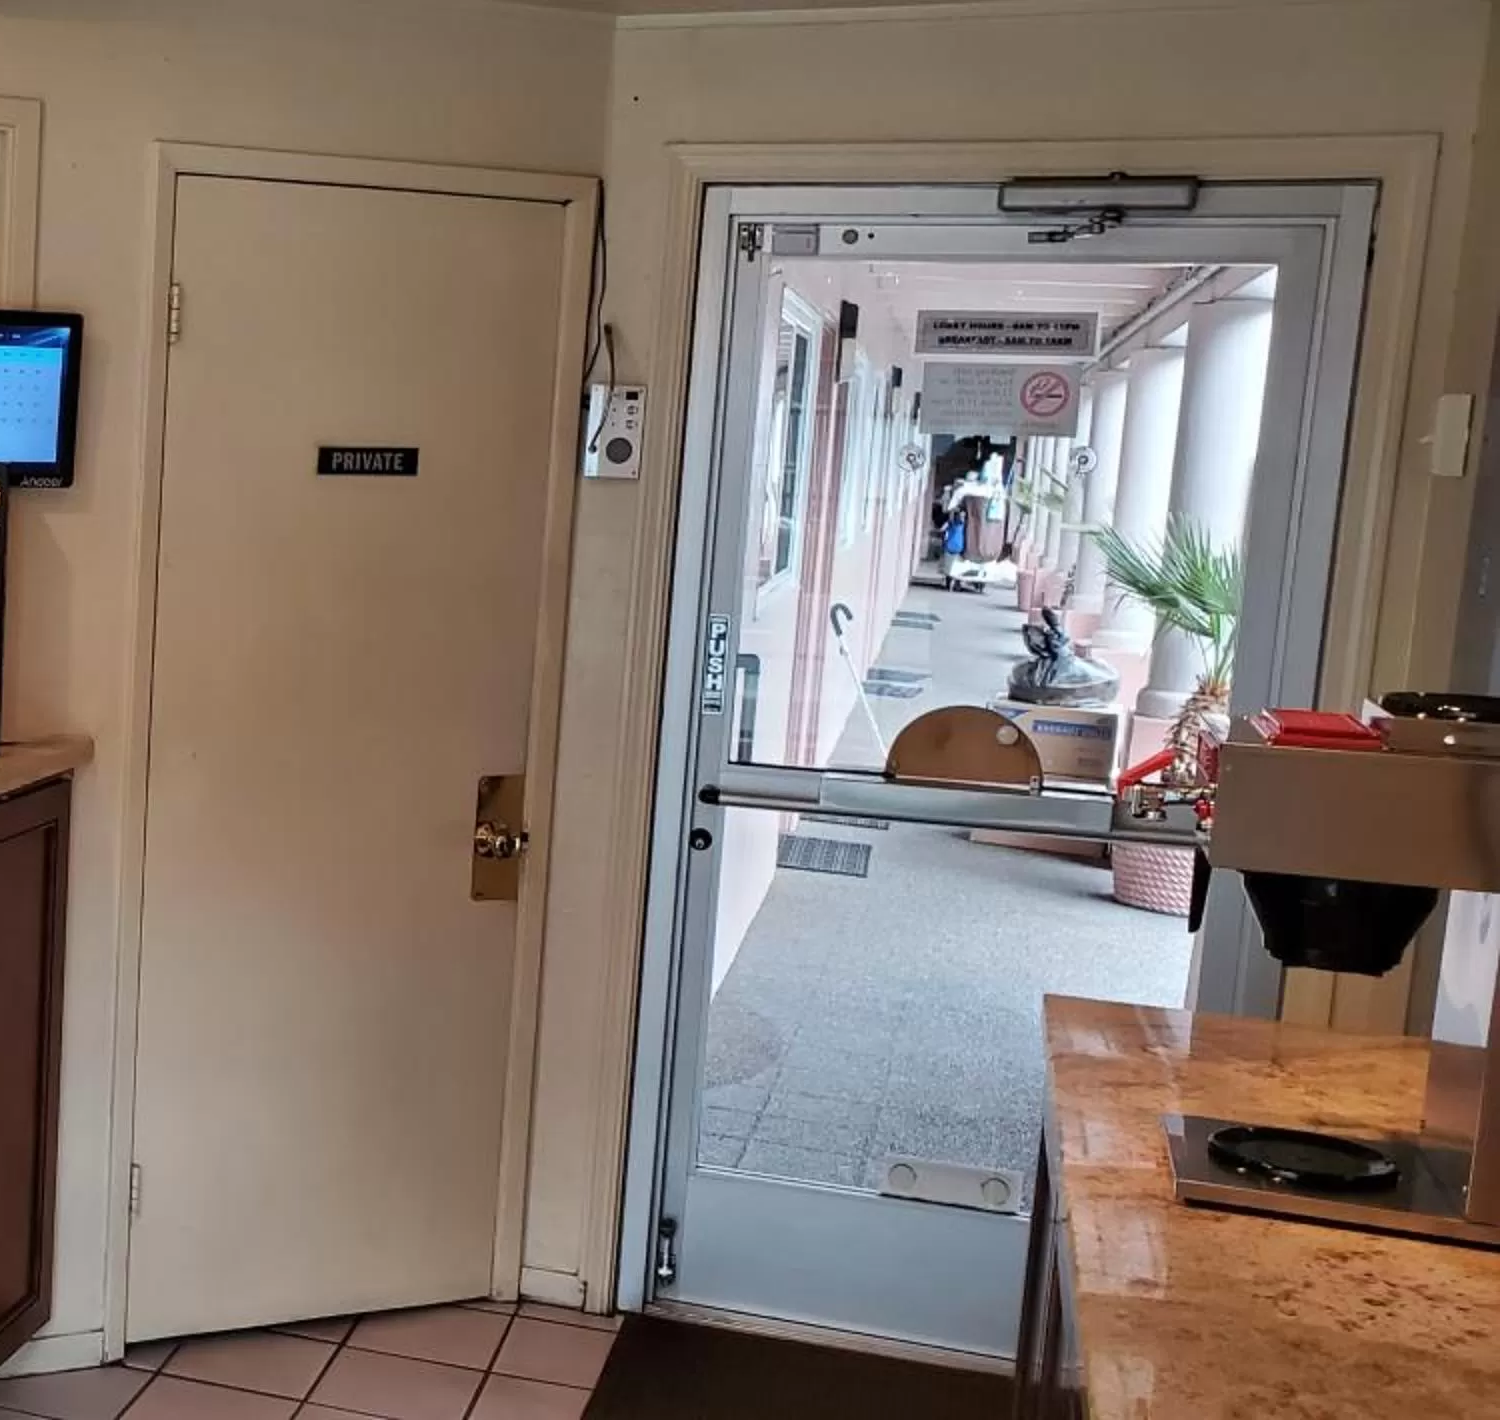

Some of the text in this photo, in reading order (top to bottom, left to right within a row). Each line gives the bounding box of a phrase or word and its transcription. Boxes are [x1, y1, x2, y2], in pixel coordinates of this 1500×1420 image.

[938, 335, 996, 345] BREAKFAST
[331, 452, 404, 471] PRIVATE
[706, 623, 726, 691] PUSH
